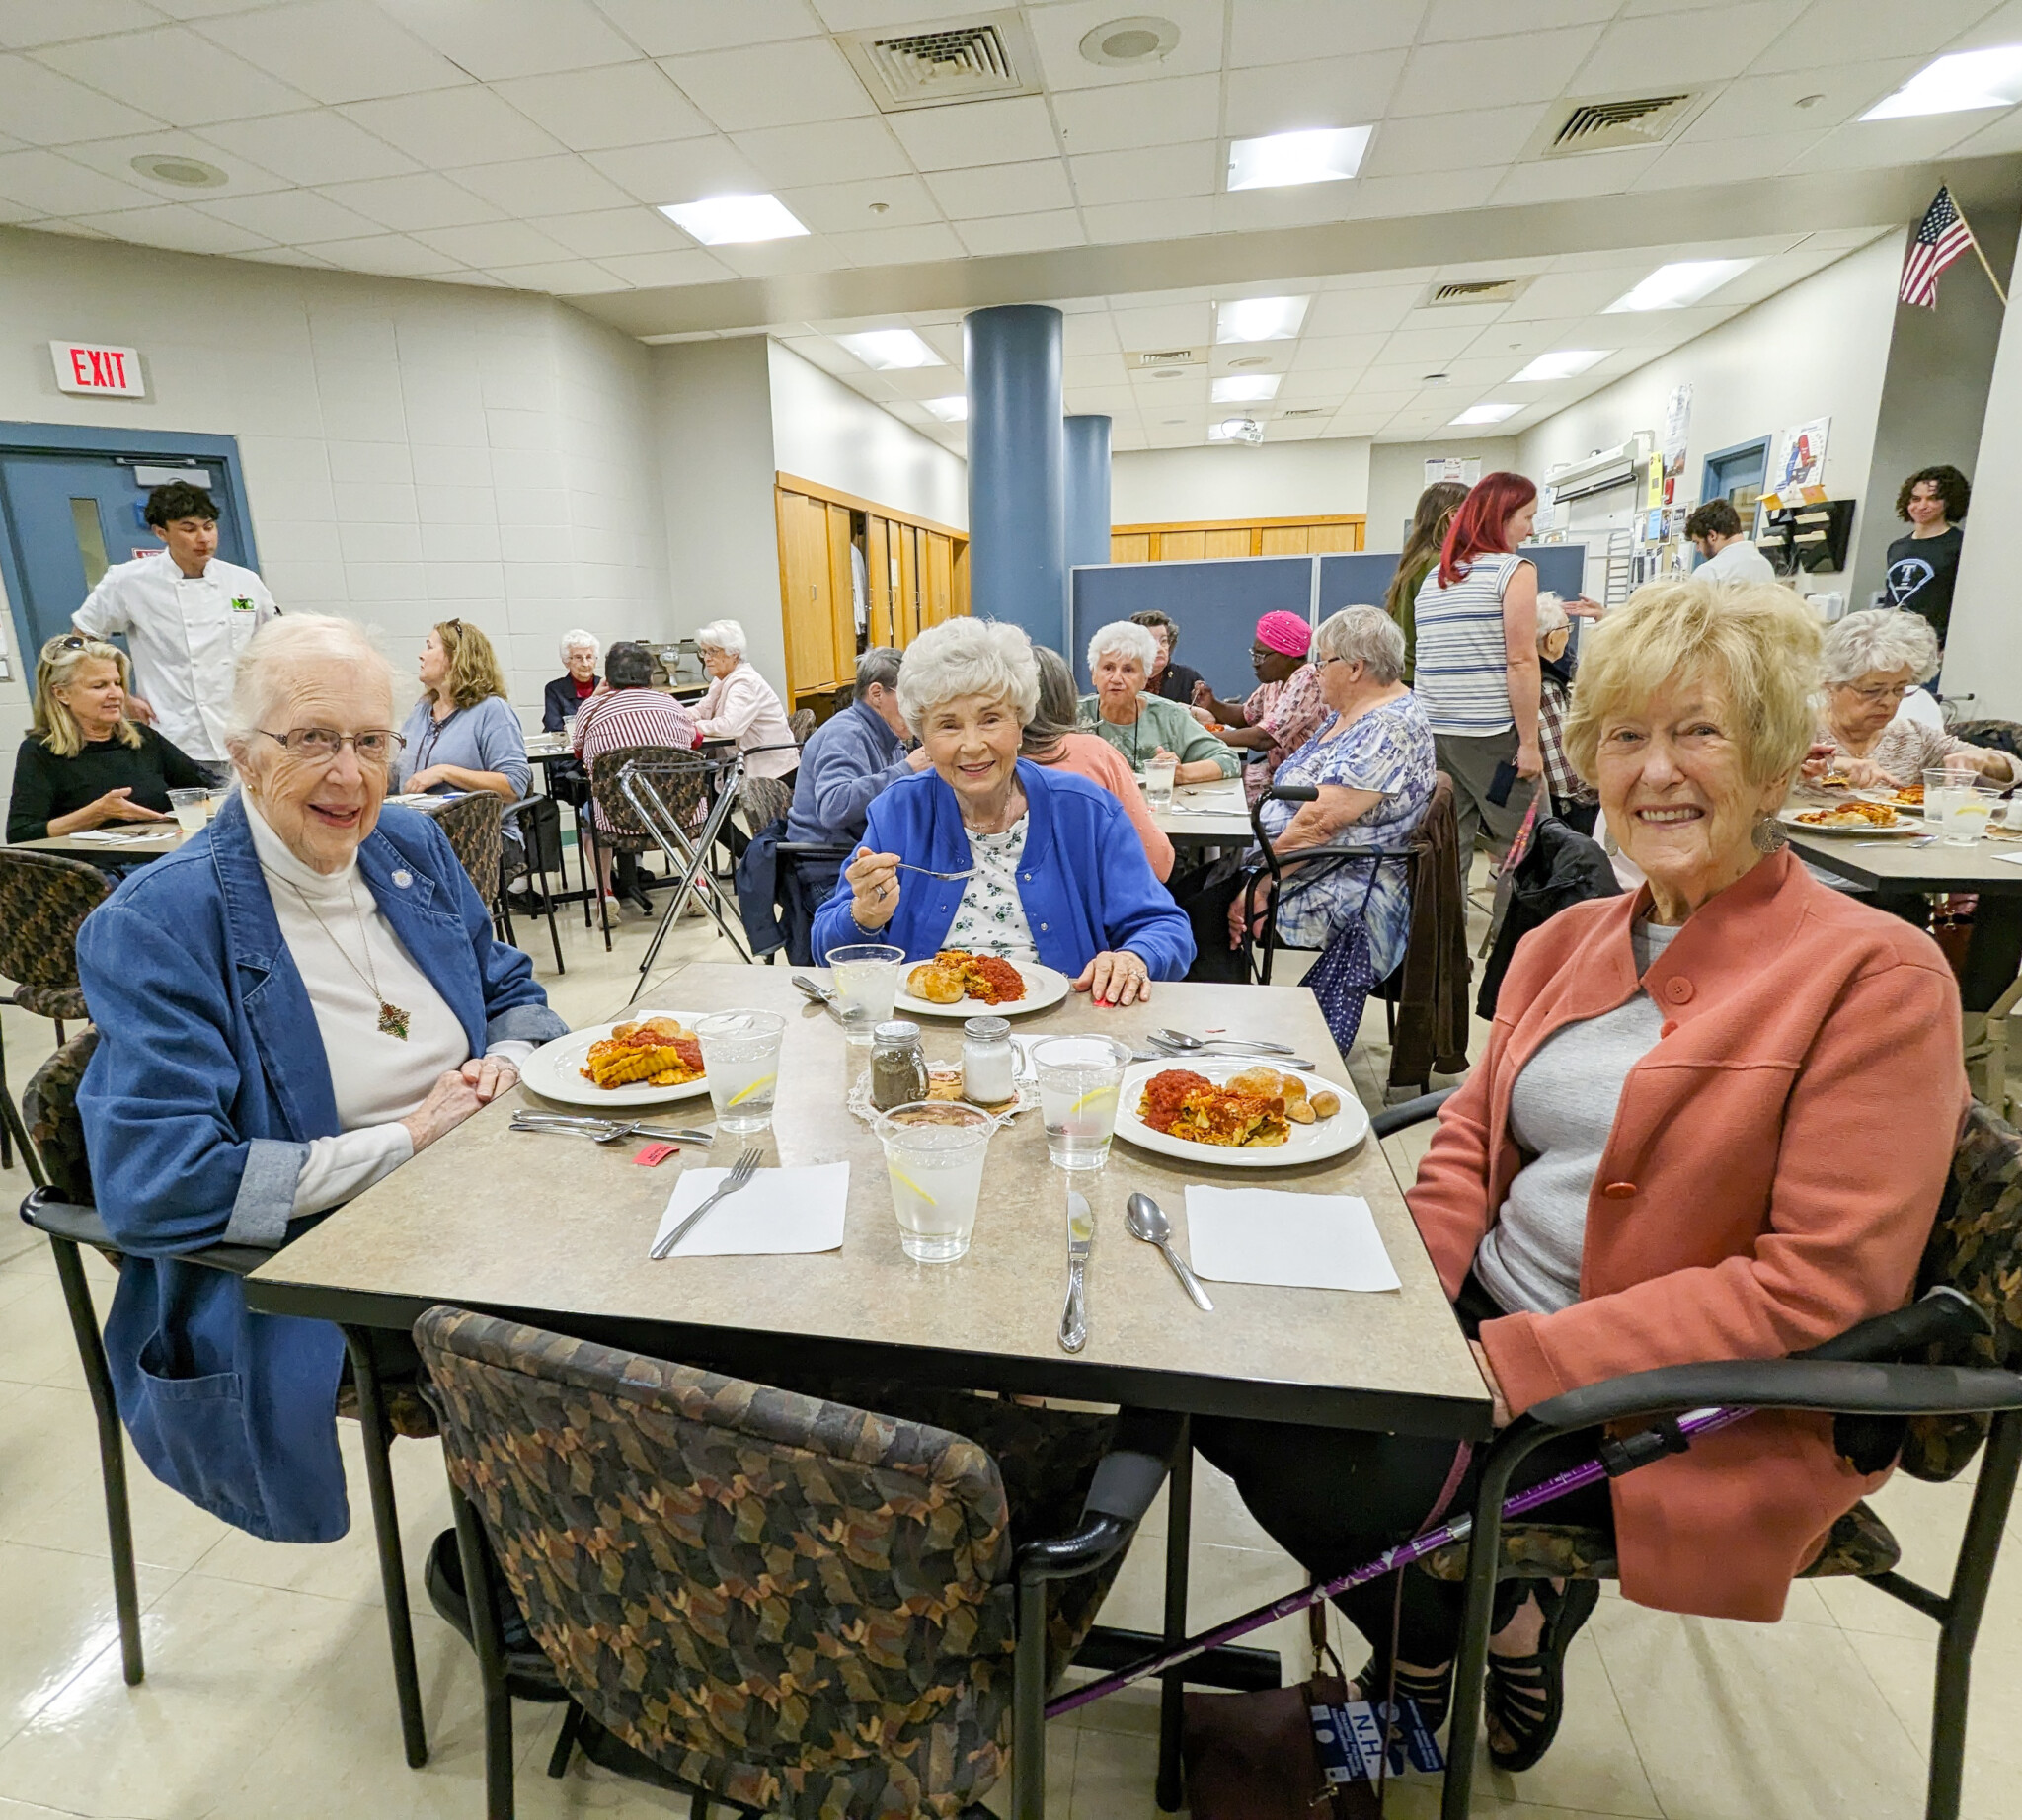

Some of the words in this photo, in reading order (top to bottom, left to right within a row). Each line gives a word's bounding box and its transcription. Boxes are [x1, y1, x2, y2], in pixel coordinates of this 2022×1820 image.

[70, 348, 126, 388] EXIT
[1901, 564, 1917, 582] T
[1353, 1715, 1382, 1764] N.H.
